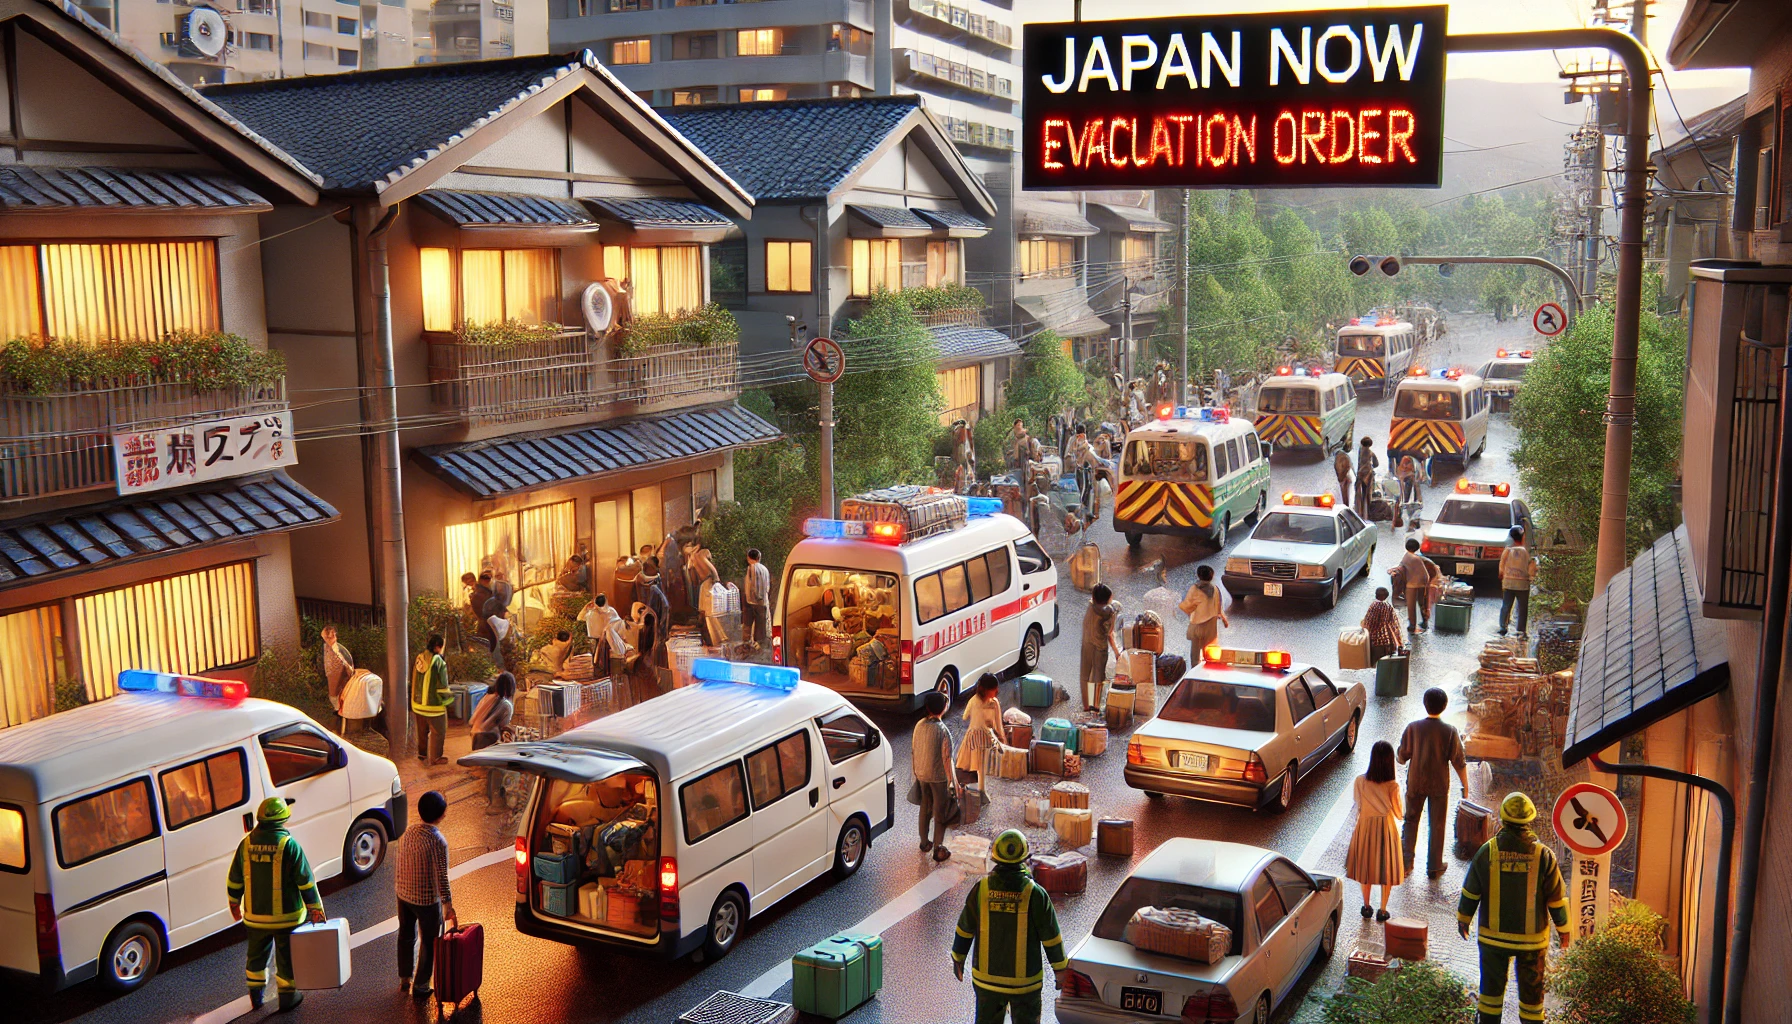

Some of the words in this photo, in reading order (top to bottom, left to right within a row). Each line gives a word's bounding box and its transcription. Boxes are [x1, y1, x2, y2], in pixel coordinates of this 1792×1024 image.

[1042, 31, 1241, 94] JAPAN
[1269, 23, 1423, 86] NOW
[1273, 107, 1417, 166] ORDER
